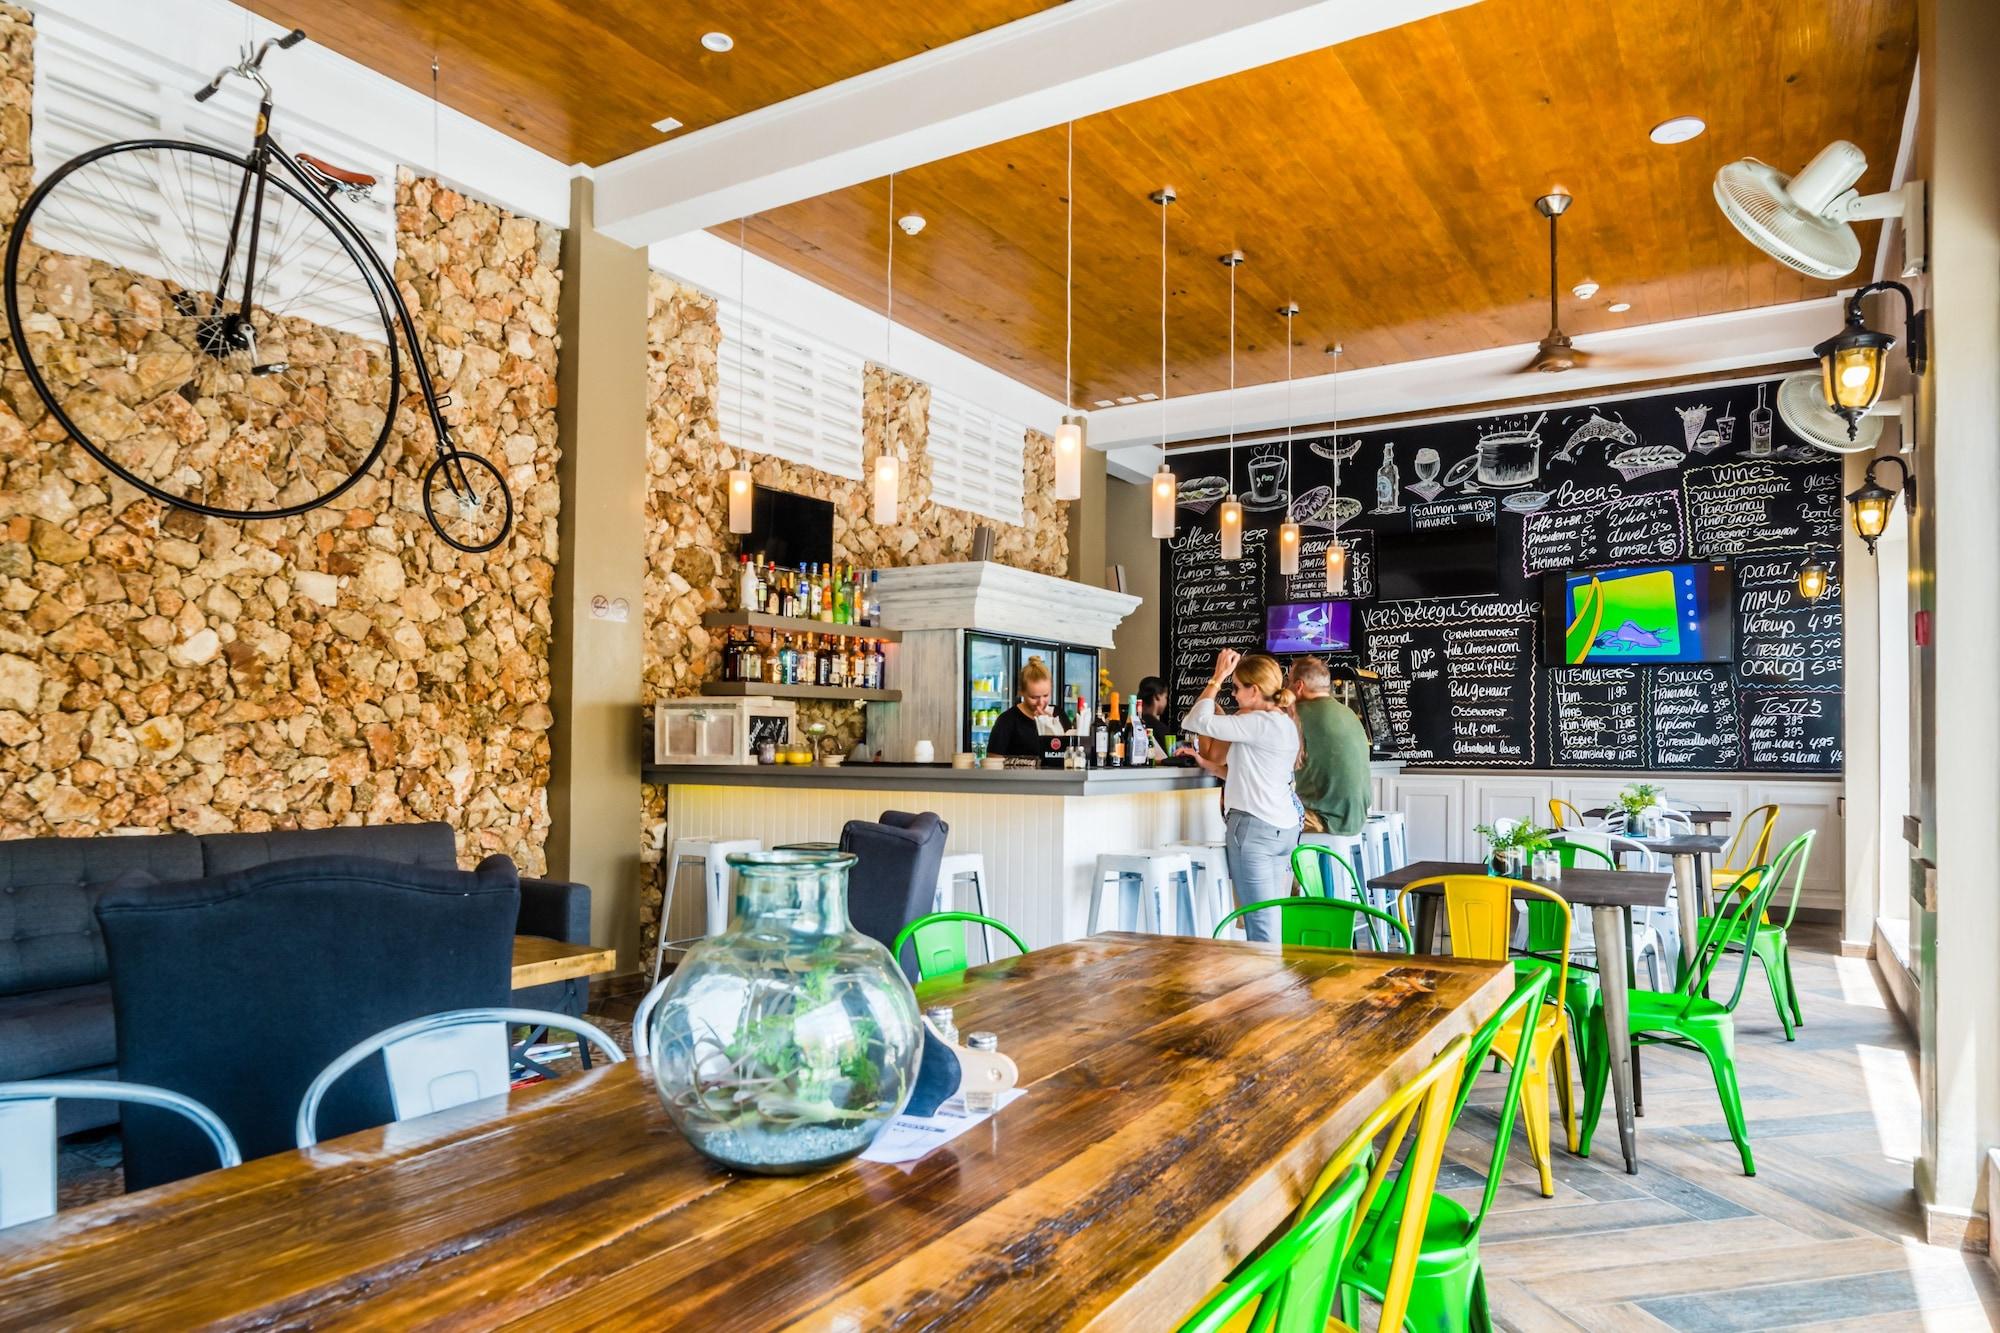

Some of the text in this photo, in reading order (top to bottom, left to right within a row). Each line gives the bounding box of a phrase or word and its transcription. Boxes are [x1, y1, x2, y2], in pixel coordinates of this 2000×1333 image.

[1711, 464, 1775, 484] Wines
[1556, 479, 1622, 508] Beers
[1351, 550, 1371, 566] $5
[1352, 580, 1373, 597] $10
[1739, 589, 1791, 615] MAYO
